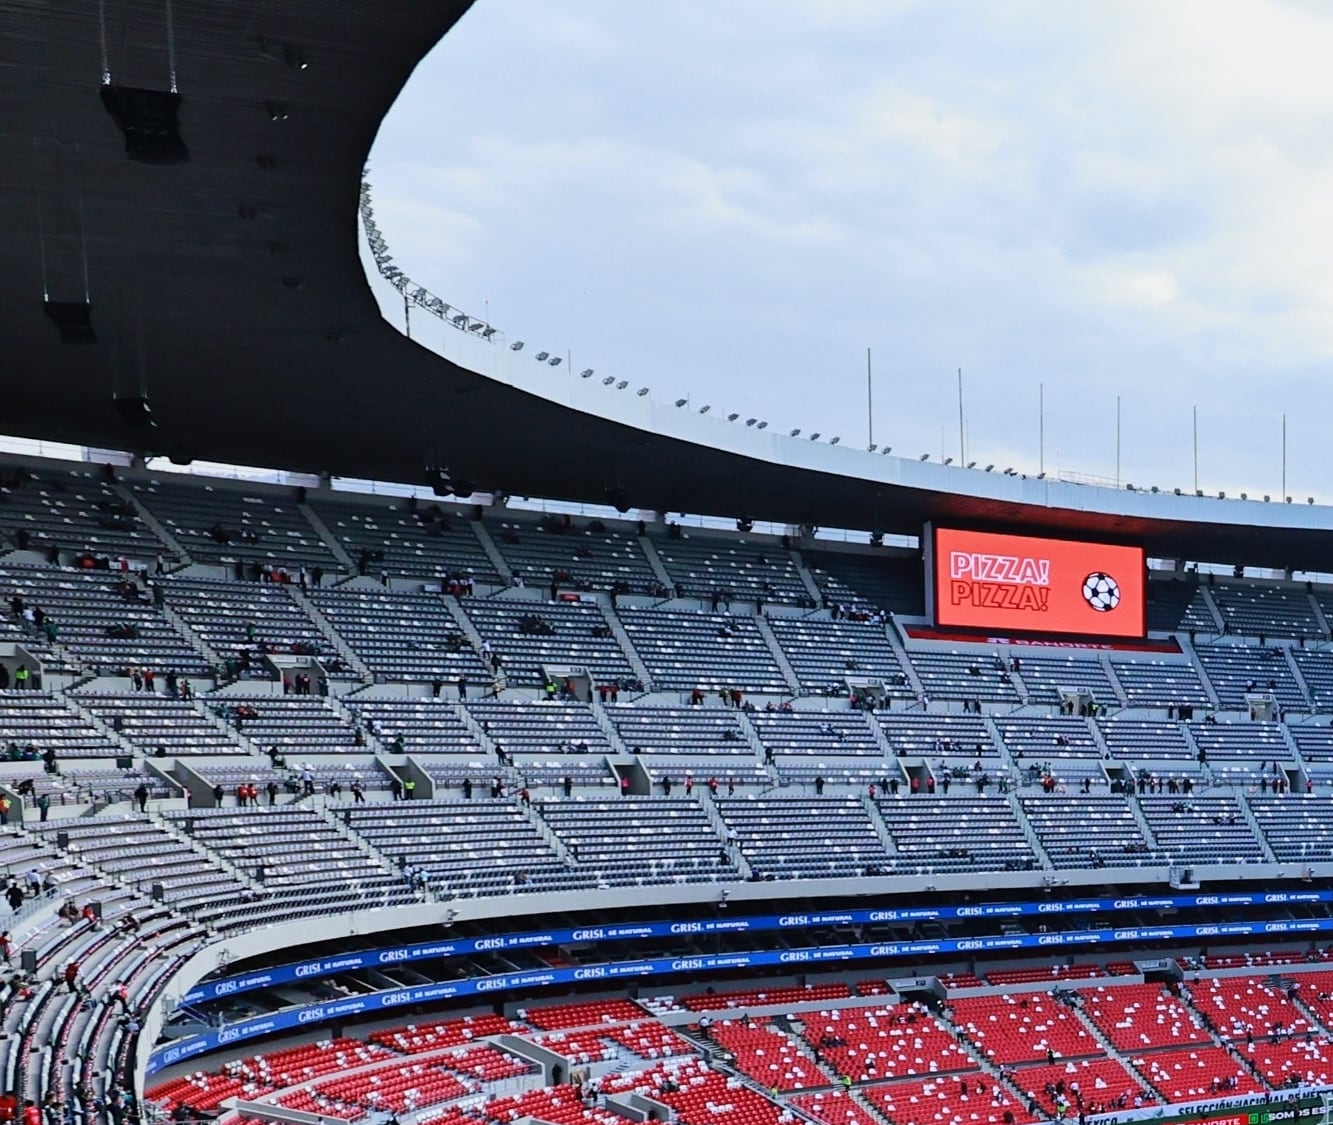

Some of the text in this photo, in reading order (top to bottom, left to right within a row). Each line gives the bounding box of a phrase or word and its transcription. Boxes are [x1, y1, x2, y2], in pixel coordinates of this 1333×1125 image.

[950, 552, 1050, 585] PIZZA!
[951, 581, 1050, 611] PIZZA!
[1015, 640, 1114, 650] BANORTE
